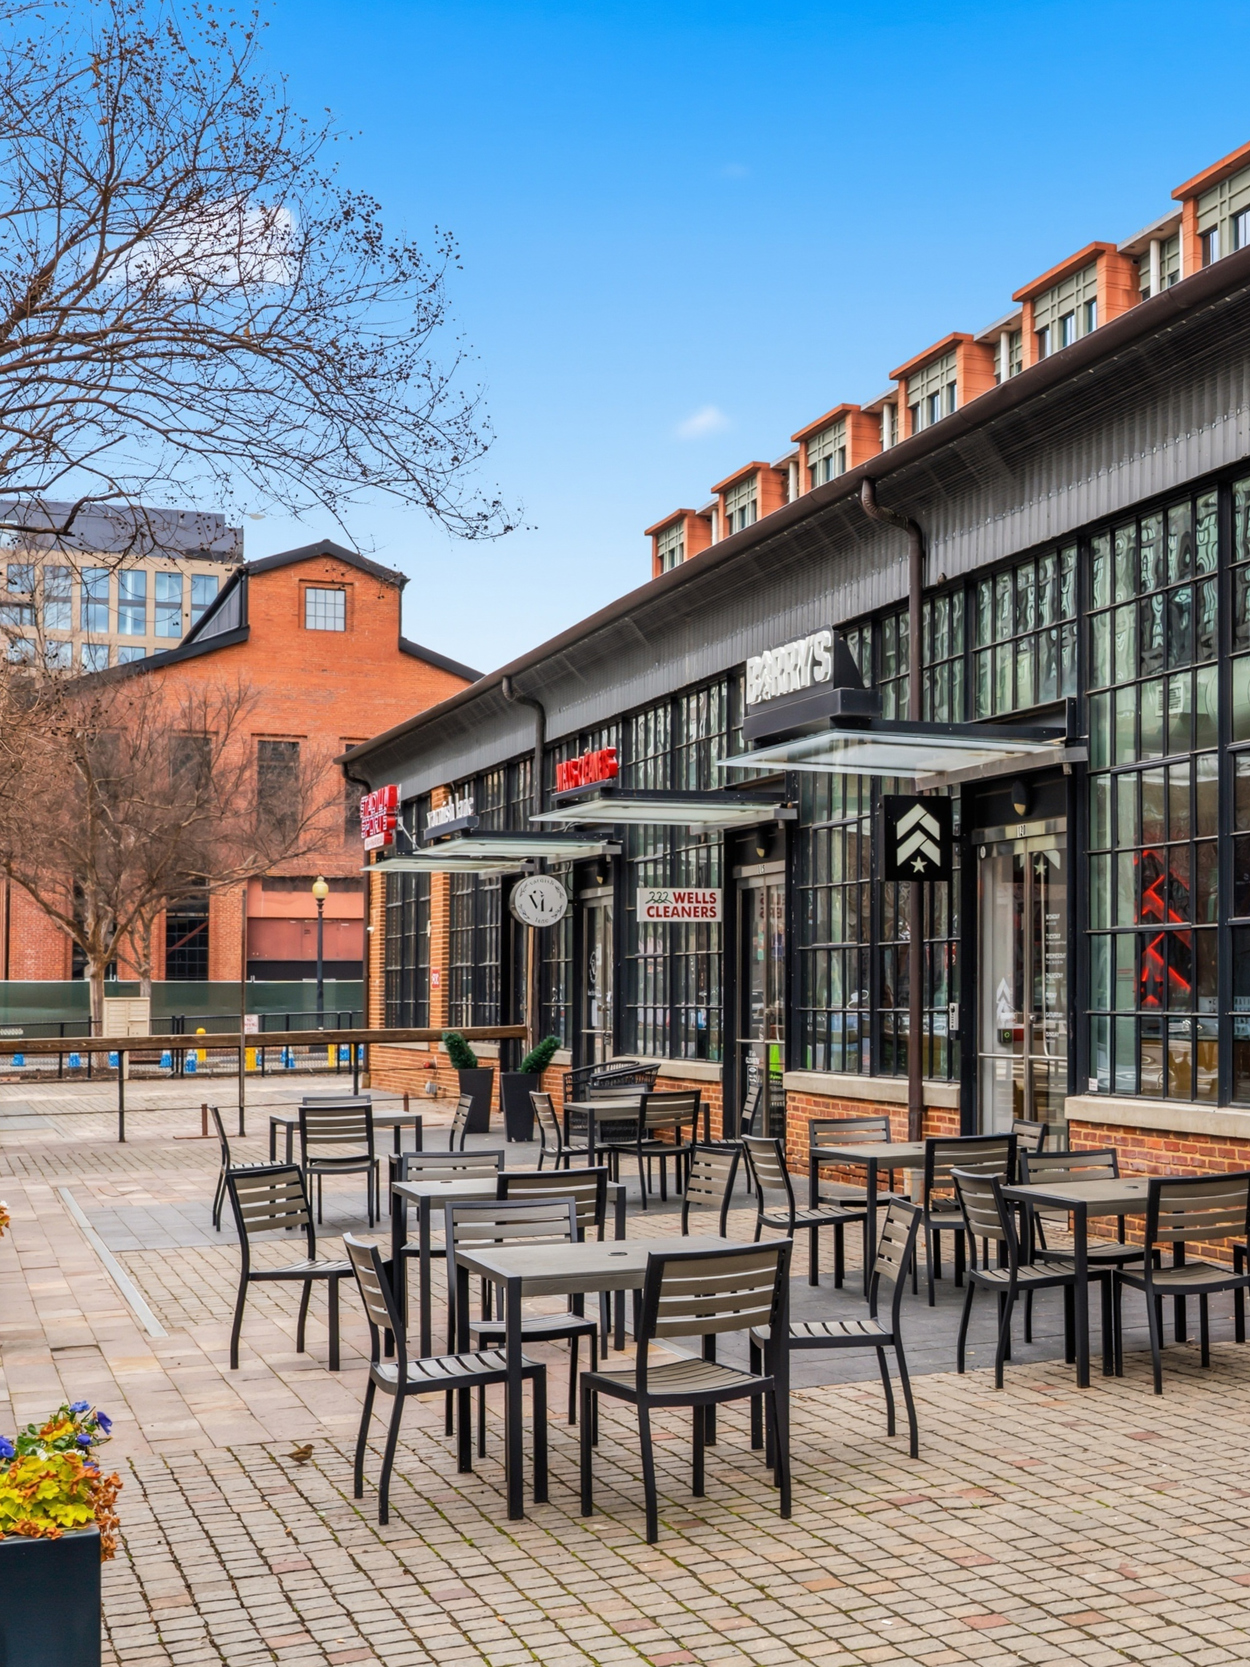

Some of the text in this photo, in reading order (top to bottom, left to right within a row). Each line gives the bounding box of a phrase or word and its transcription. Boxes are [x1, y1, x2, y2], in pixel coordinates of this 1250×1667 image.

[745, 630, 832, 705] BARRY'S
[672, 891, 717, 904] WELLS
[646, 905, 717, 919] CLEANERS
